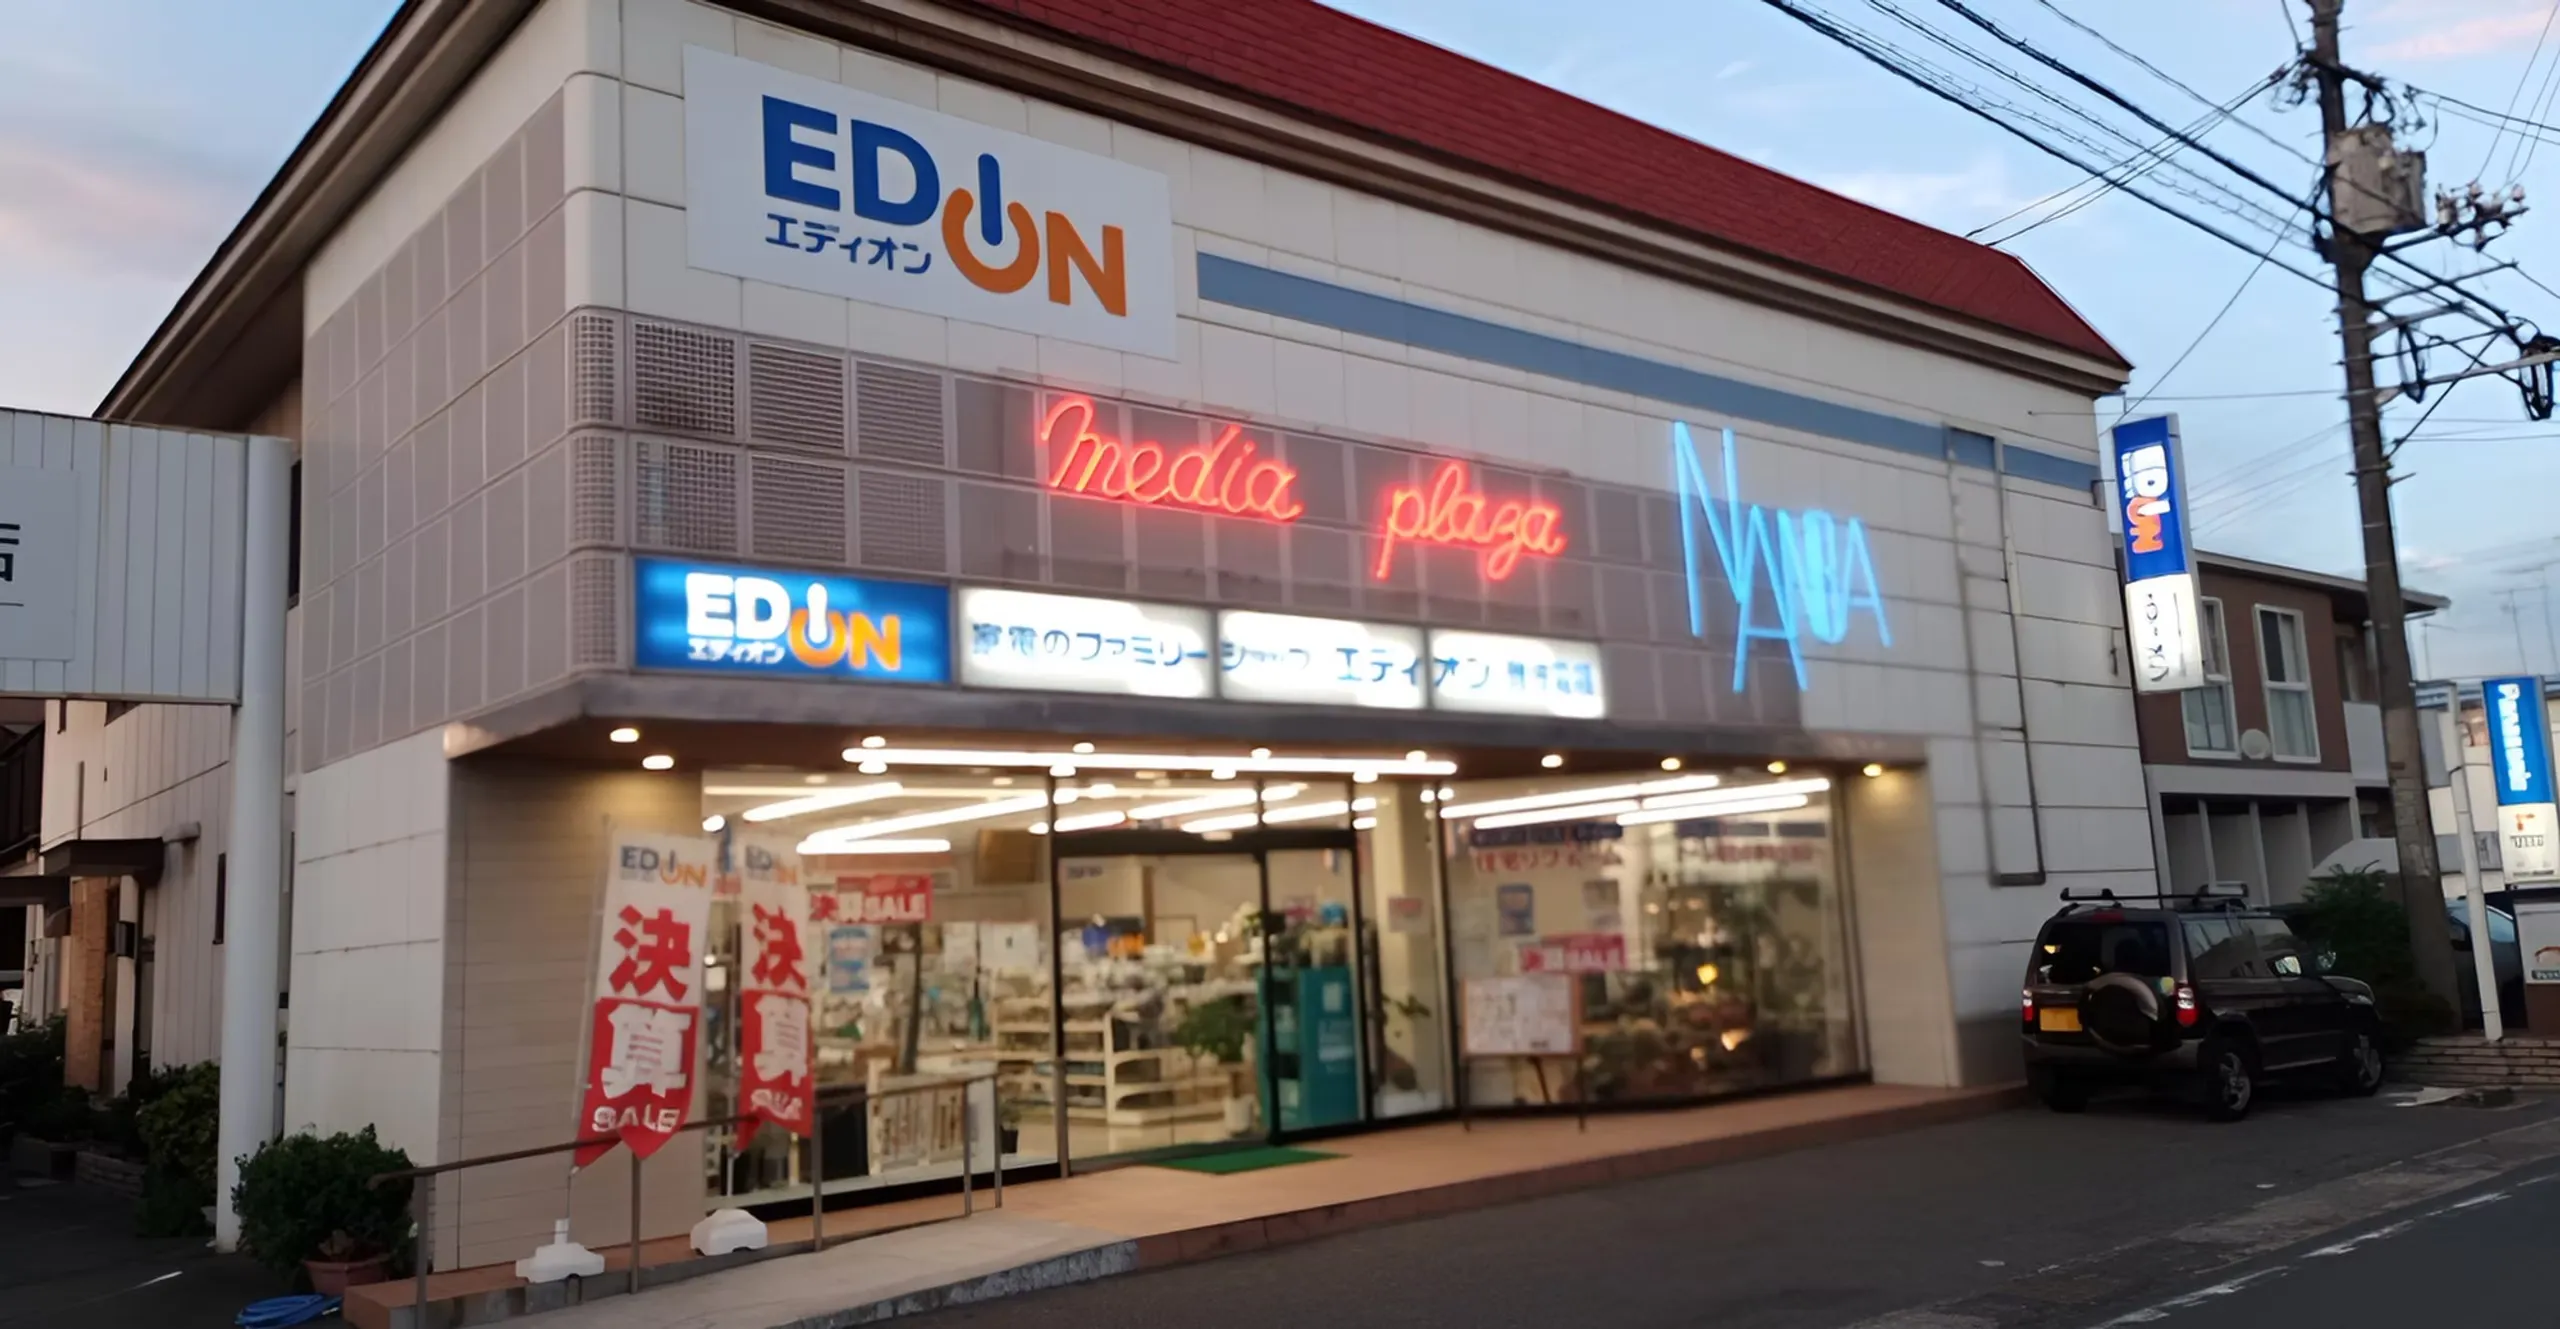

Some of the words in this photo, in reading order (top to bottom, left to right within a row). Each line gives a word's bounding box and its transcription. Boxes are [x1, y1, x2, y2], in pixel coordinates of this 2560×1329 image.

[762, 94, 1127, 317] EDION
[765, 213, 932, 275] エディオン
[1040, 394, 1303, 523] media
[1376, 461, 1568, 580] plaza
[686, 572, 901, 671] EDION
[620, 845, 706, 888] EDION
[592, 1105, 680, 1133] SALE
